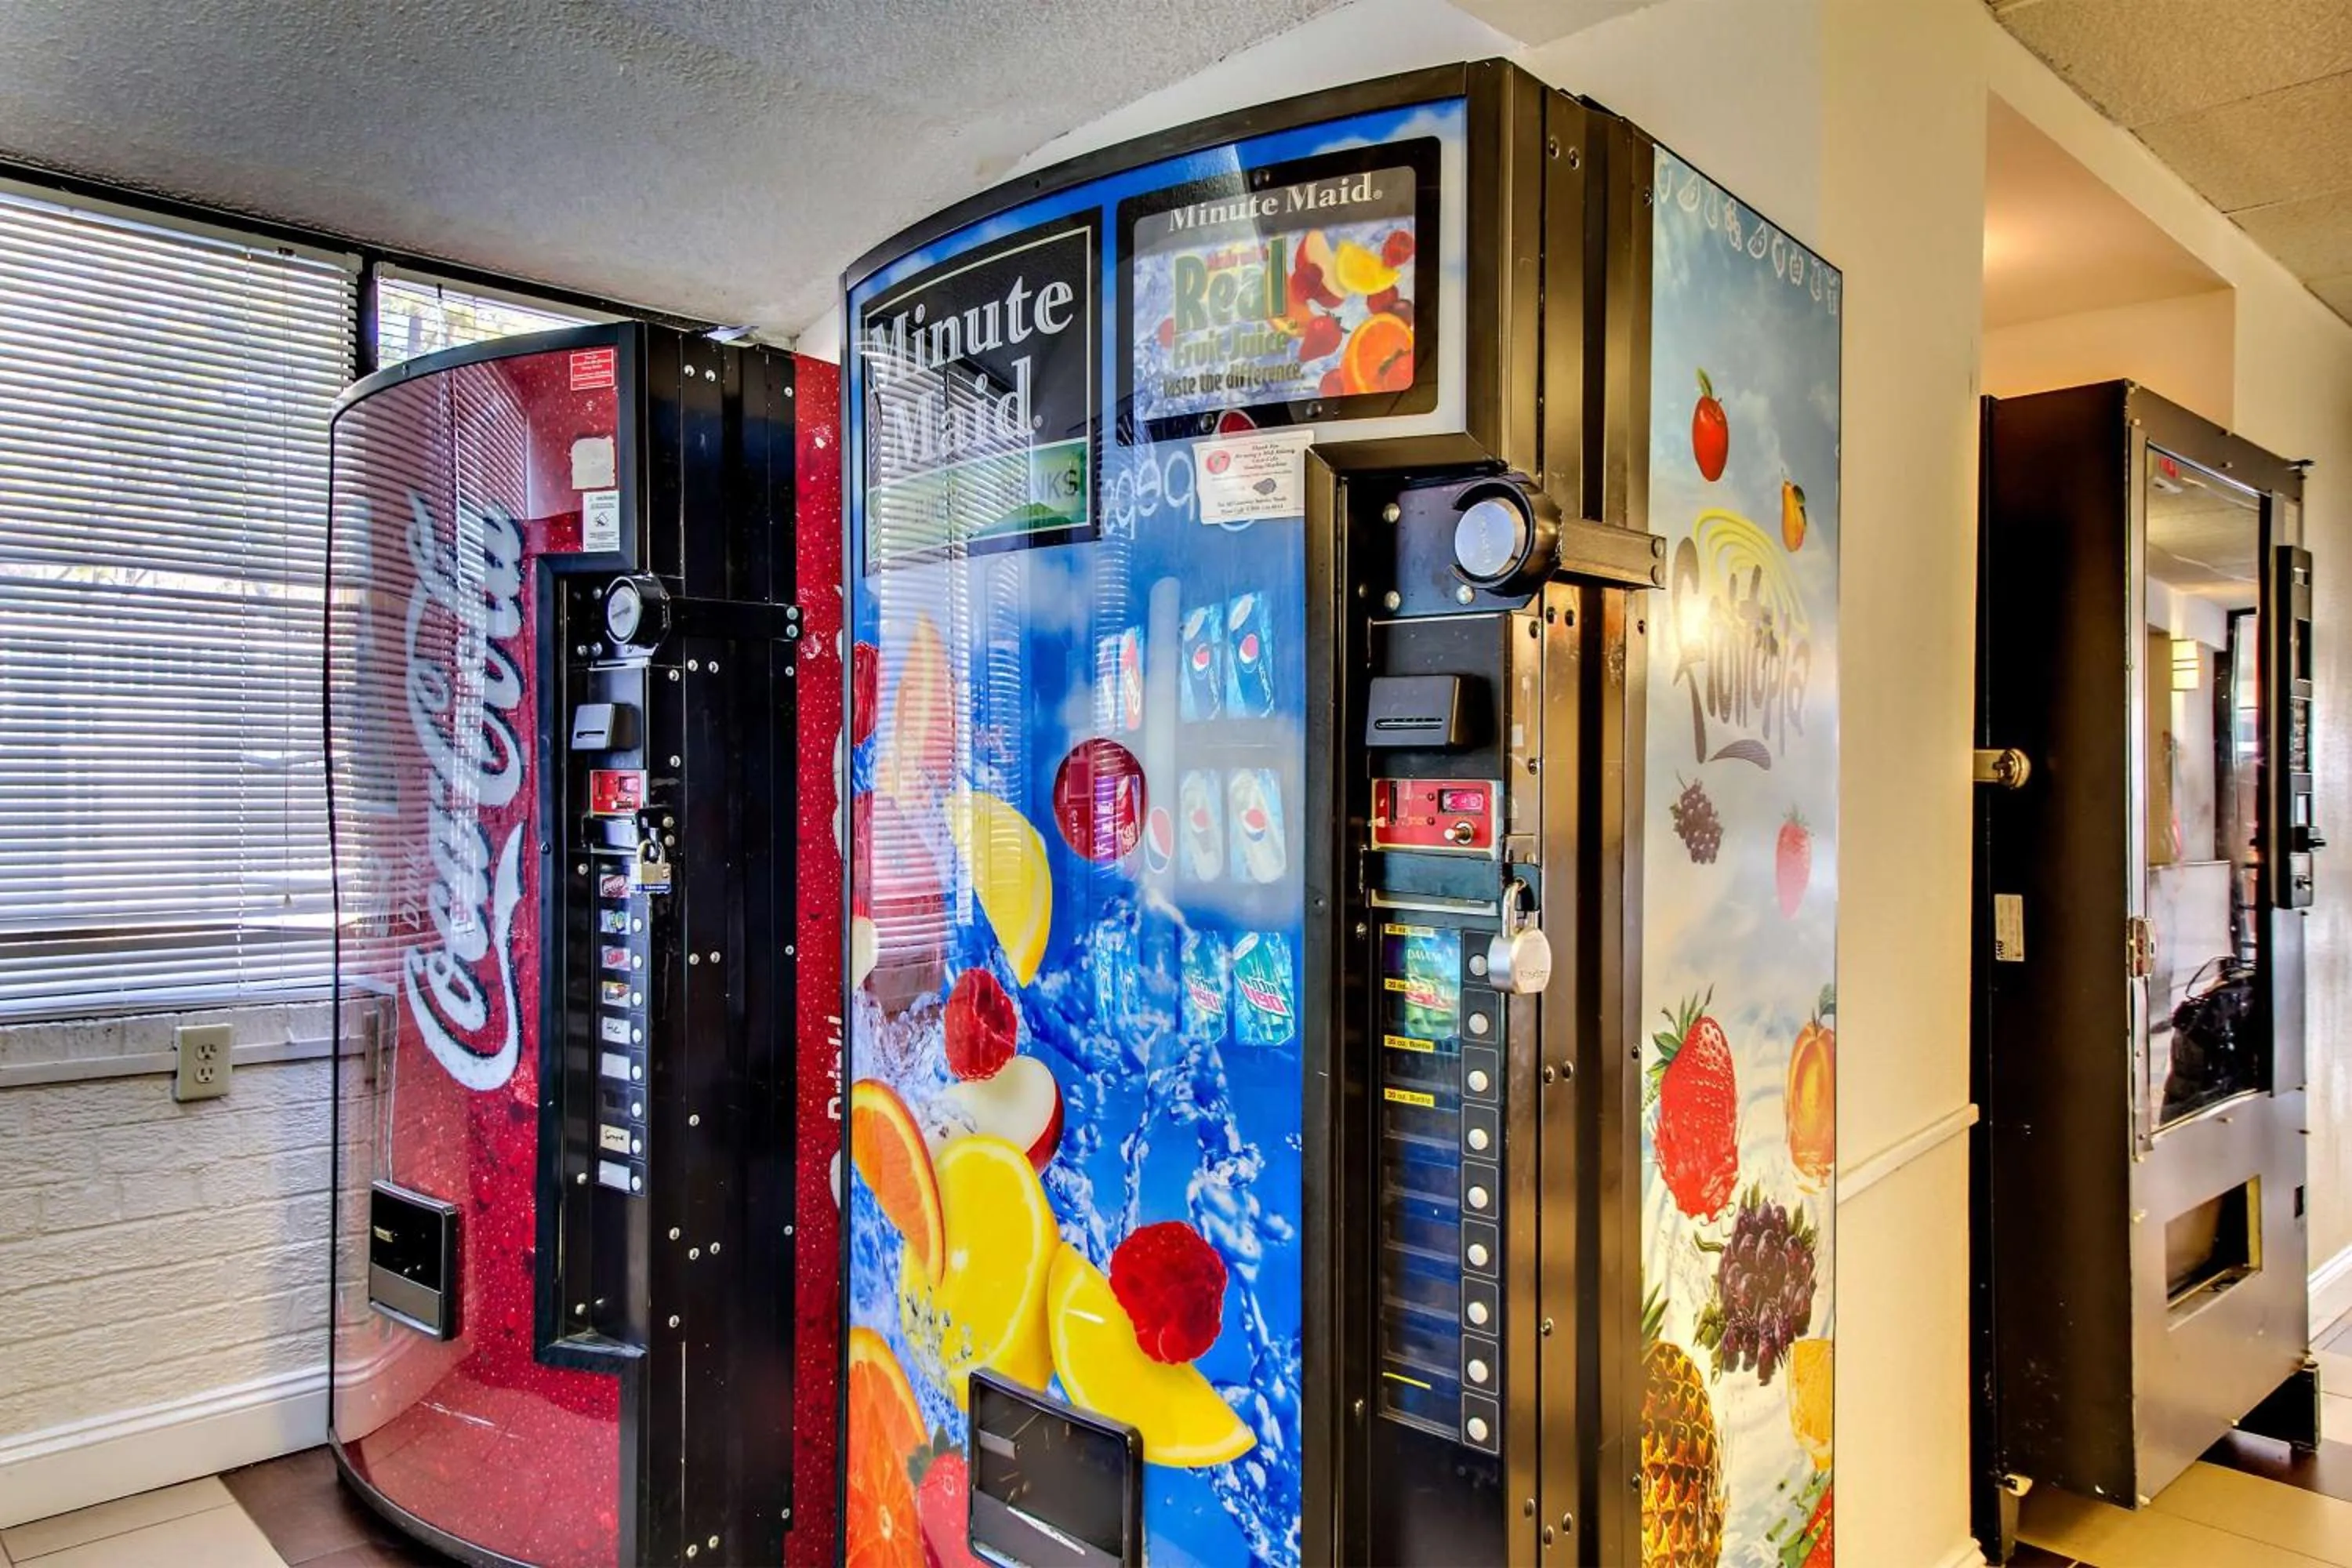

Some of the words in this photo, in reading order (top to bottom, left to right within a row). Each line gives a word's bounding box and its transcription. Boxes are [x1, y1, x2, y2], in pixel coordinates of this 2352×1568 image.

[1168, 193, 1279, 231] Minute
[1286, 172, 1372, 212] Maid
[870, 275, 1074, 387] Minute
[1174, 237, 1287, 333] Real
[1228, 322, 1287, 363] Juice
[892, 354, 1035, 463] Maid
